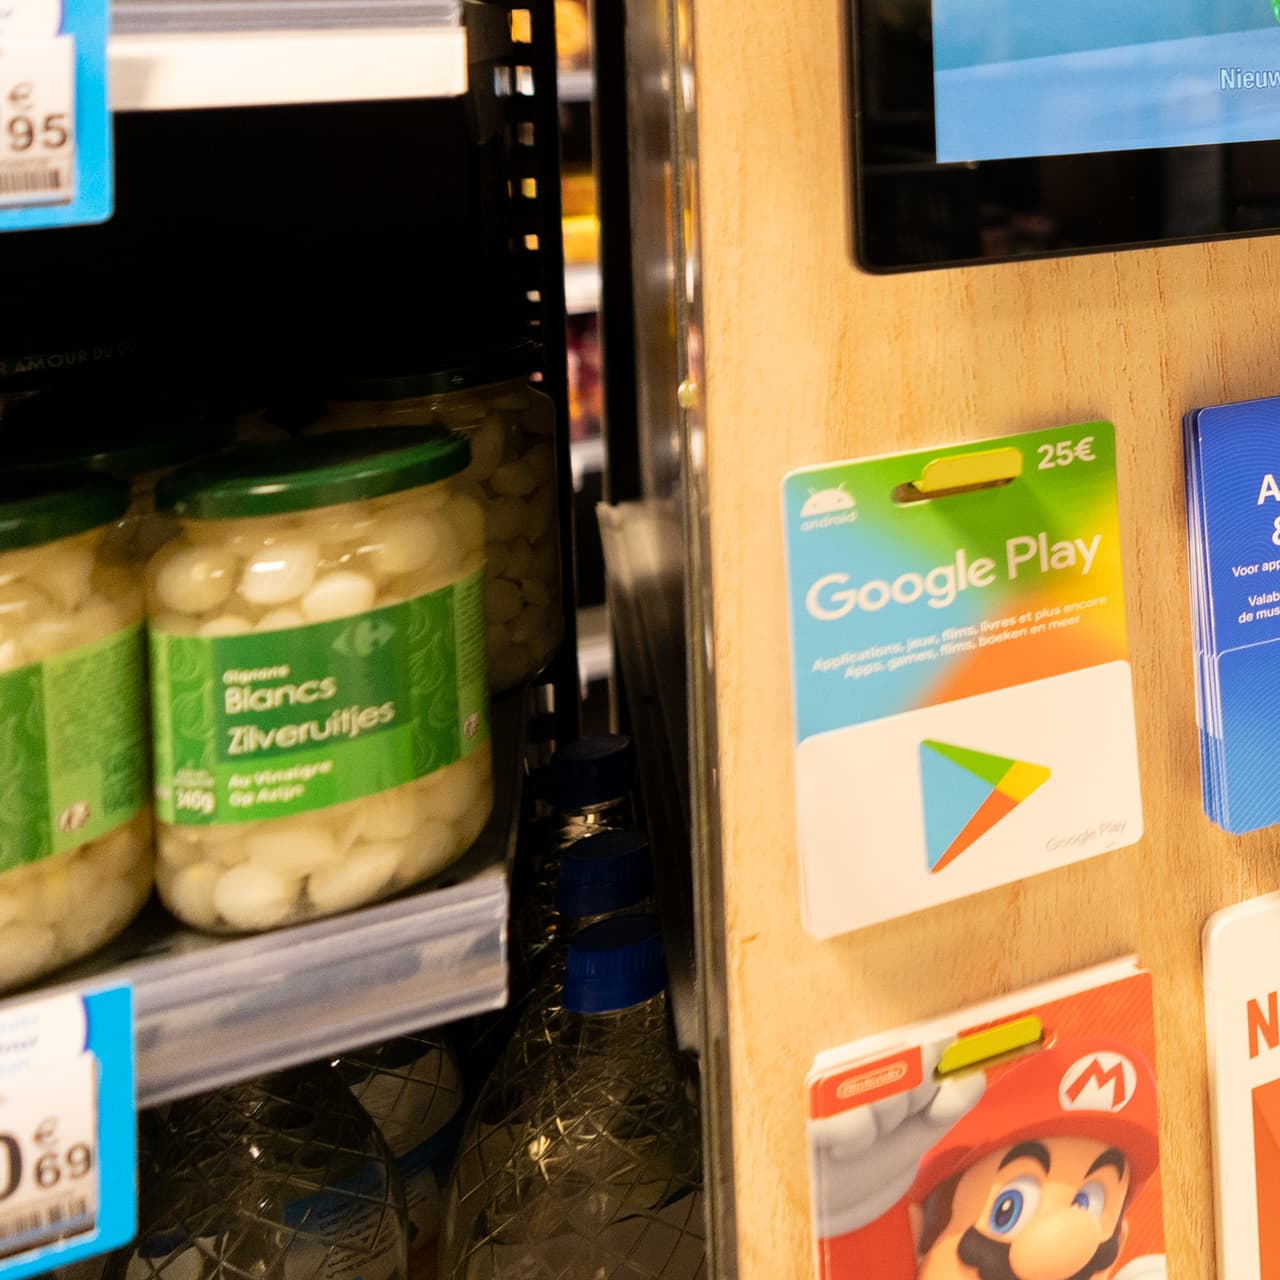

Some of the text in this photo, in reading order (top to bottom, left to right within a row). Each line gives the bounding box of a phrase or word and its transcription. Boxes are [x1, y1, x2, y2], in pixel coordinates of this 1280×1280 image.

[1036, 435, 1097, 470] 25€
[805, 531, 1103, 621] Google Play
[1231, 563, 1260, 578] Voor
[1018, 612, 1034, 625] et
[1034, 605, 1062, 623] plus
[1062, 595, 1109, 613] encore
[1238, 611, 1254, 625] de
[977, 628, 1029, 648] boeken
[1029, 623, 1047, 635] en
[1047, 615, 1081, 631] meer
[224, 676, 337, 715] Blancs
[228, 700, 397, 756] Zilveruitjes
[1045, 828, 1097, 853] Google
